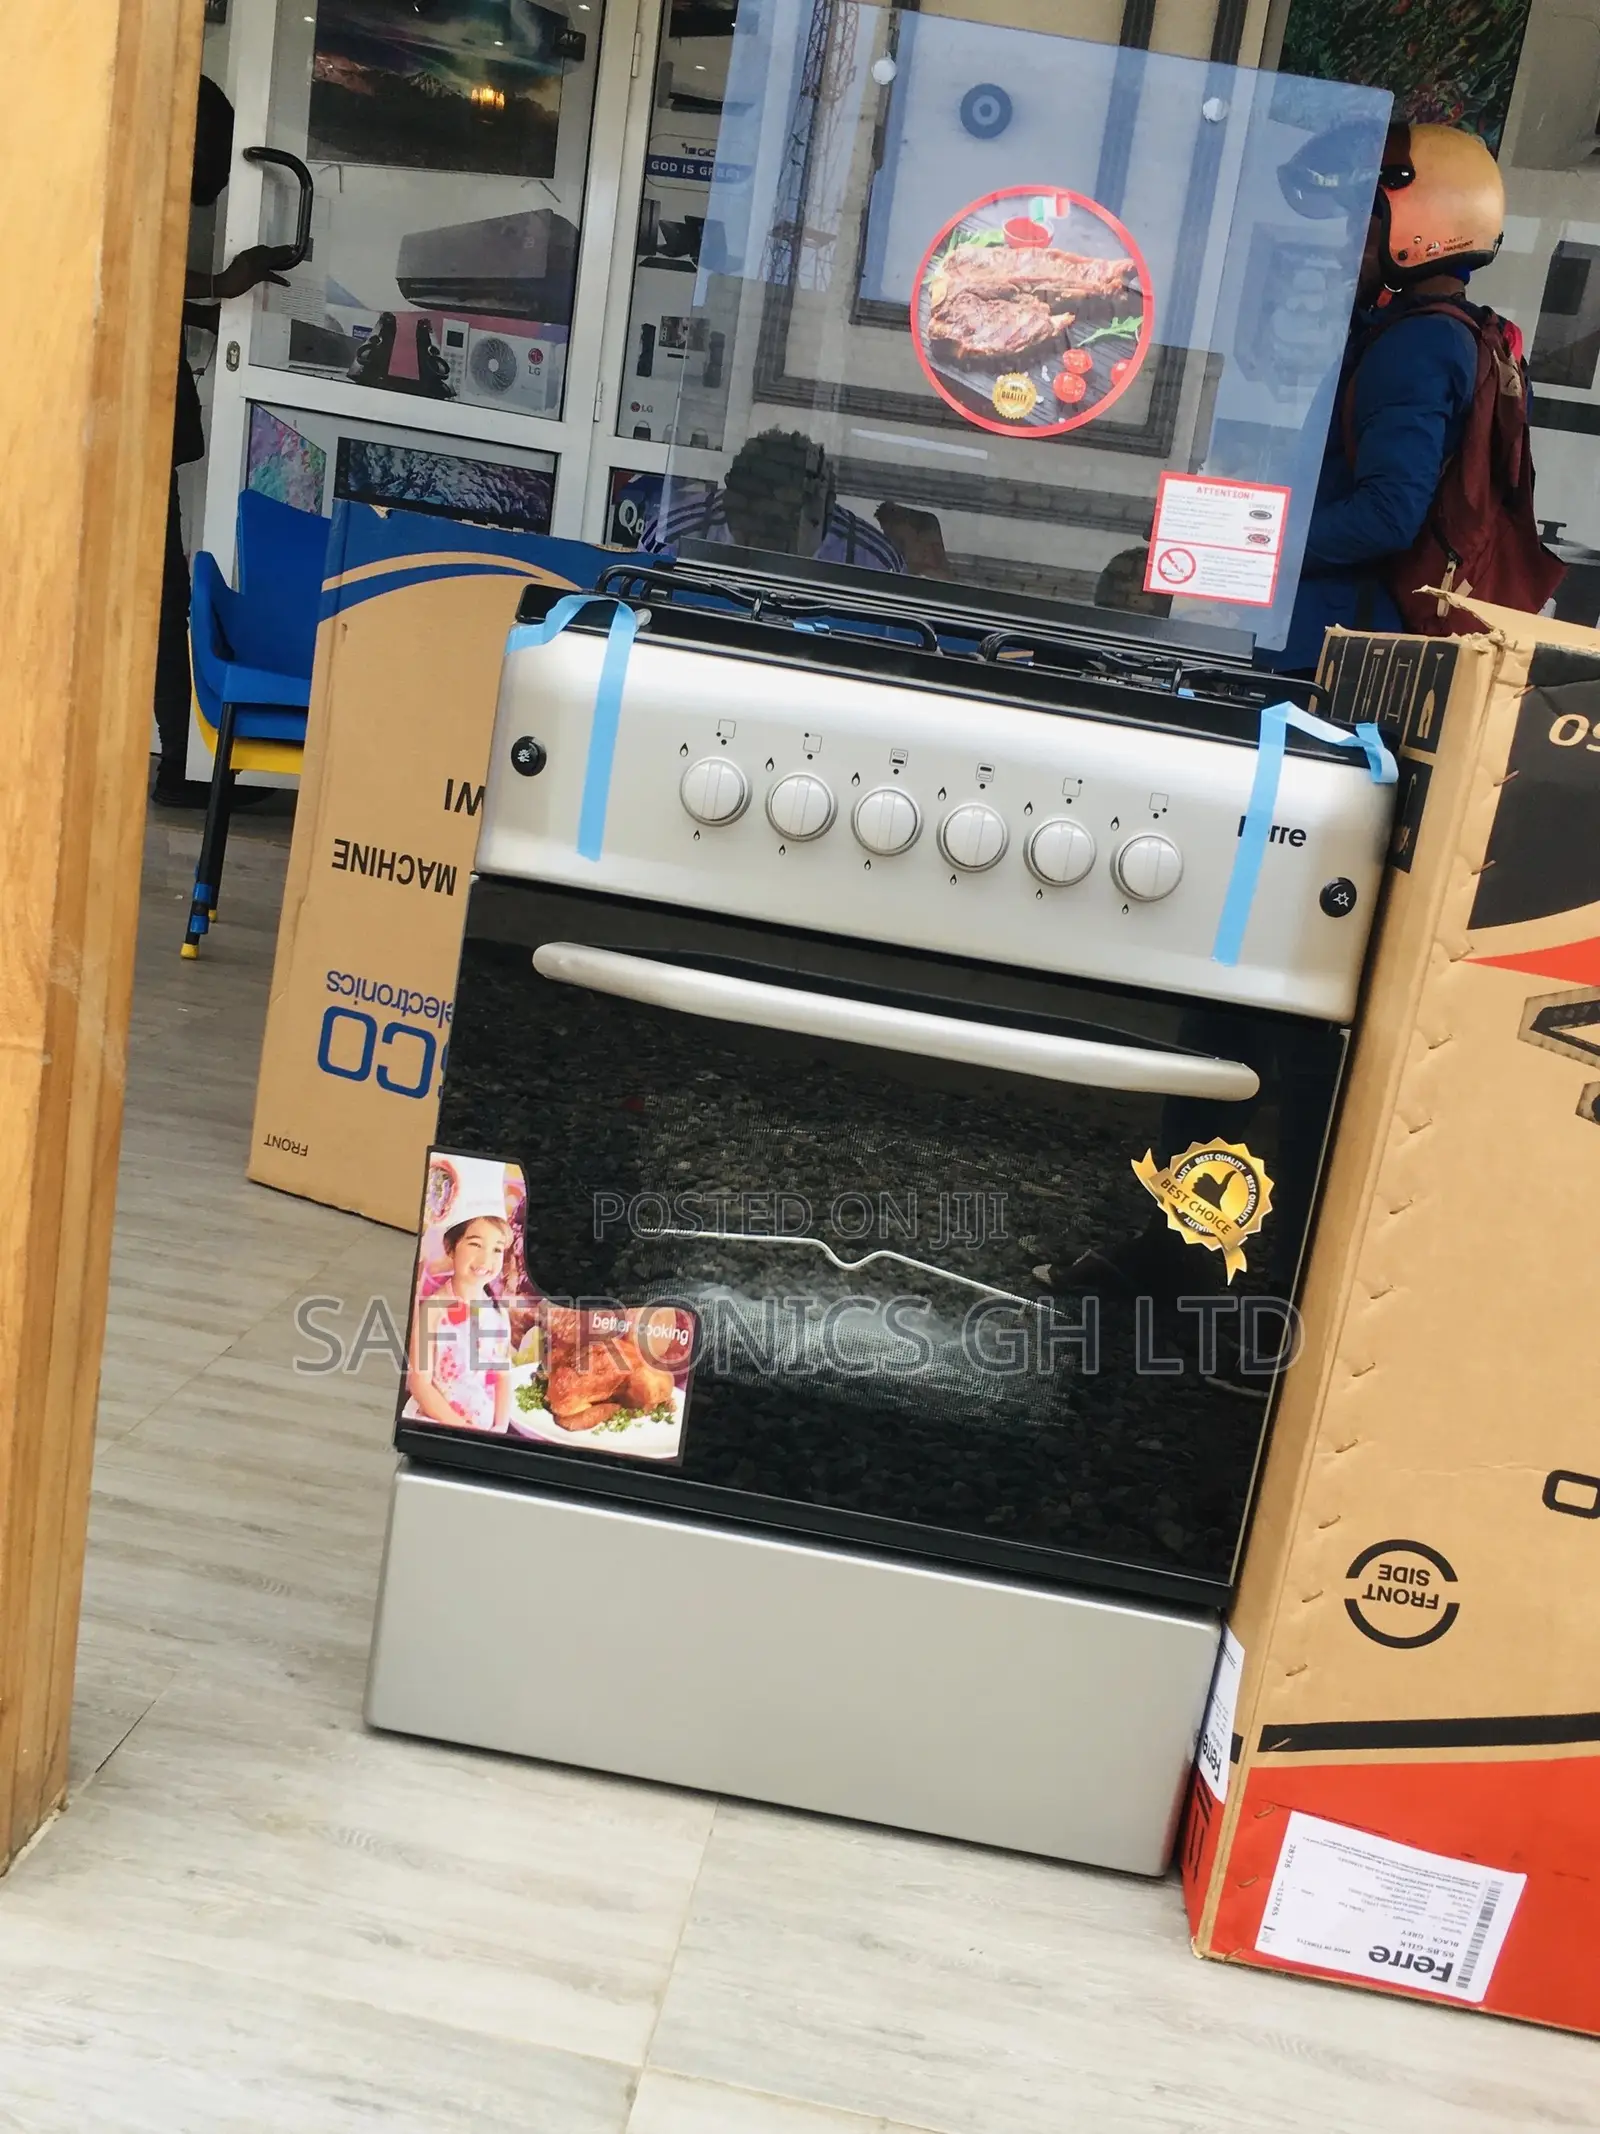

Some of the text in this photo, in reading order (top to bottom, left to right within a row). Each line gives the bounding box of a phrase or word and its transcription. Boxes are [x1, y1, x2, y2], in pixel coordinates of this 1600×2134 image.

[651, 160, 678, 172] GOD
[682, 164, 695, 175] IS
[528, 365, 542, 377] LG
[1196, 485, 1255, 501] ATTENTION!
[331, 838, 458, 897] MACHINE
[263, 1133, 309, 1157] FRONT
[1194, 1153, 1247, 1171] BEST QUALITY
[1160, 1178, 1232, 1235] BEST CHOICE
[1237, 1174, 1257, 1225] BEST QUALITY
[592, 1312, 690, 1347] better cooking
[1377, 1563, 1431, 1587] SIDE
[1361, 1583, 1440, 1611] FRONT
[1202, 1733, 1222, 1783] Ferre
[1400, 1929, 1460, 1948] BLACK GREY
[1367, 1944, 1454, 1983] Ferre
